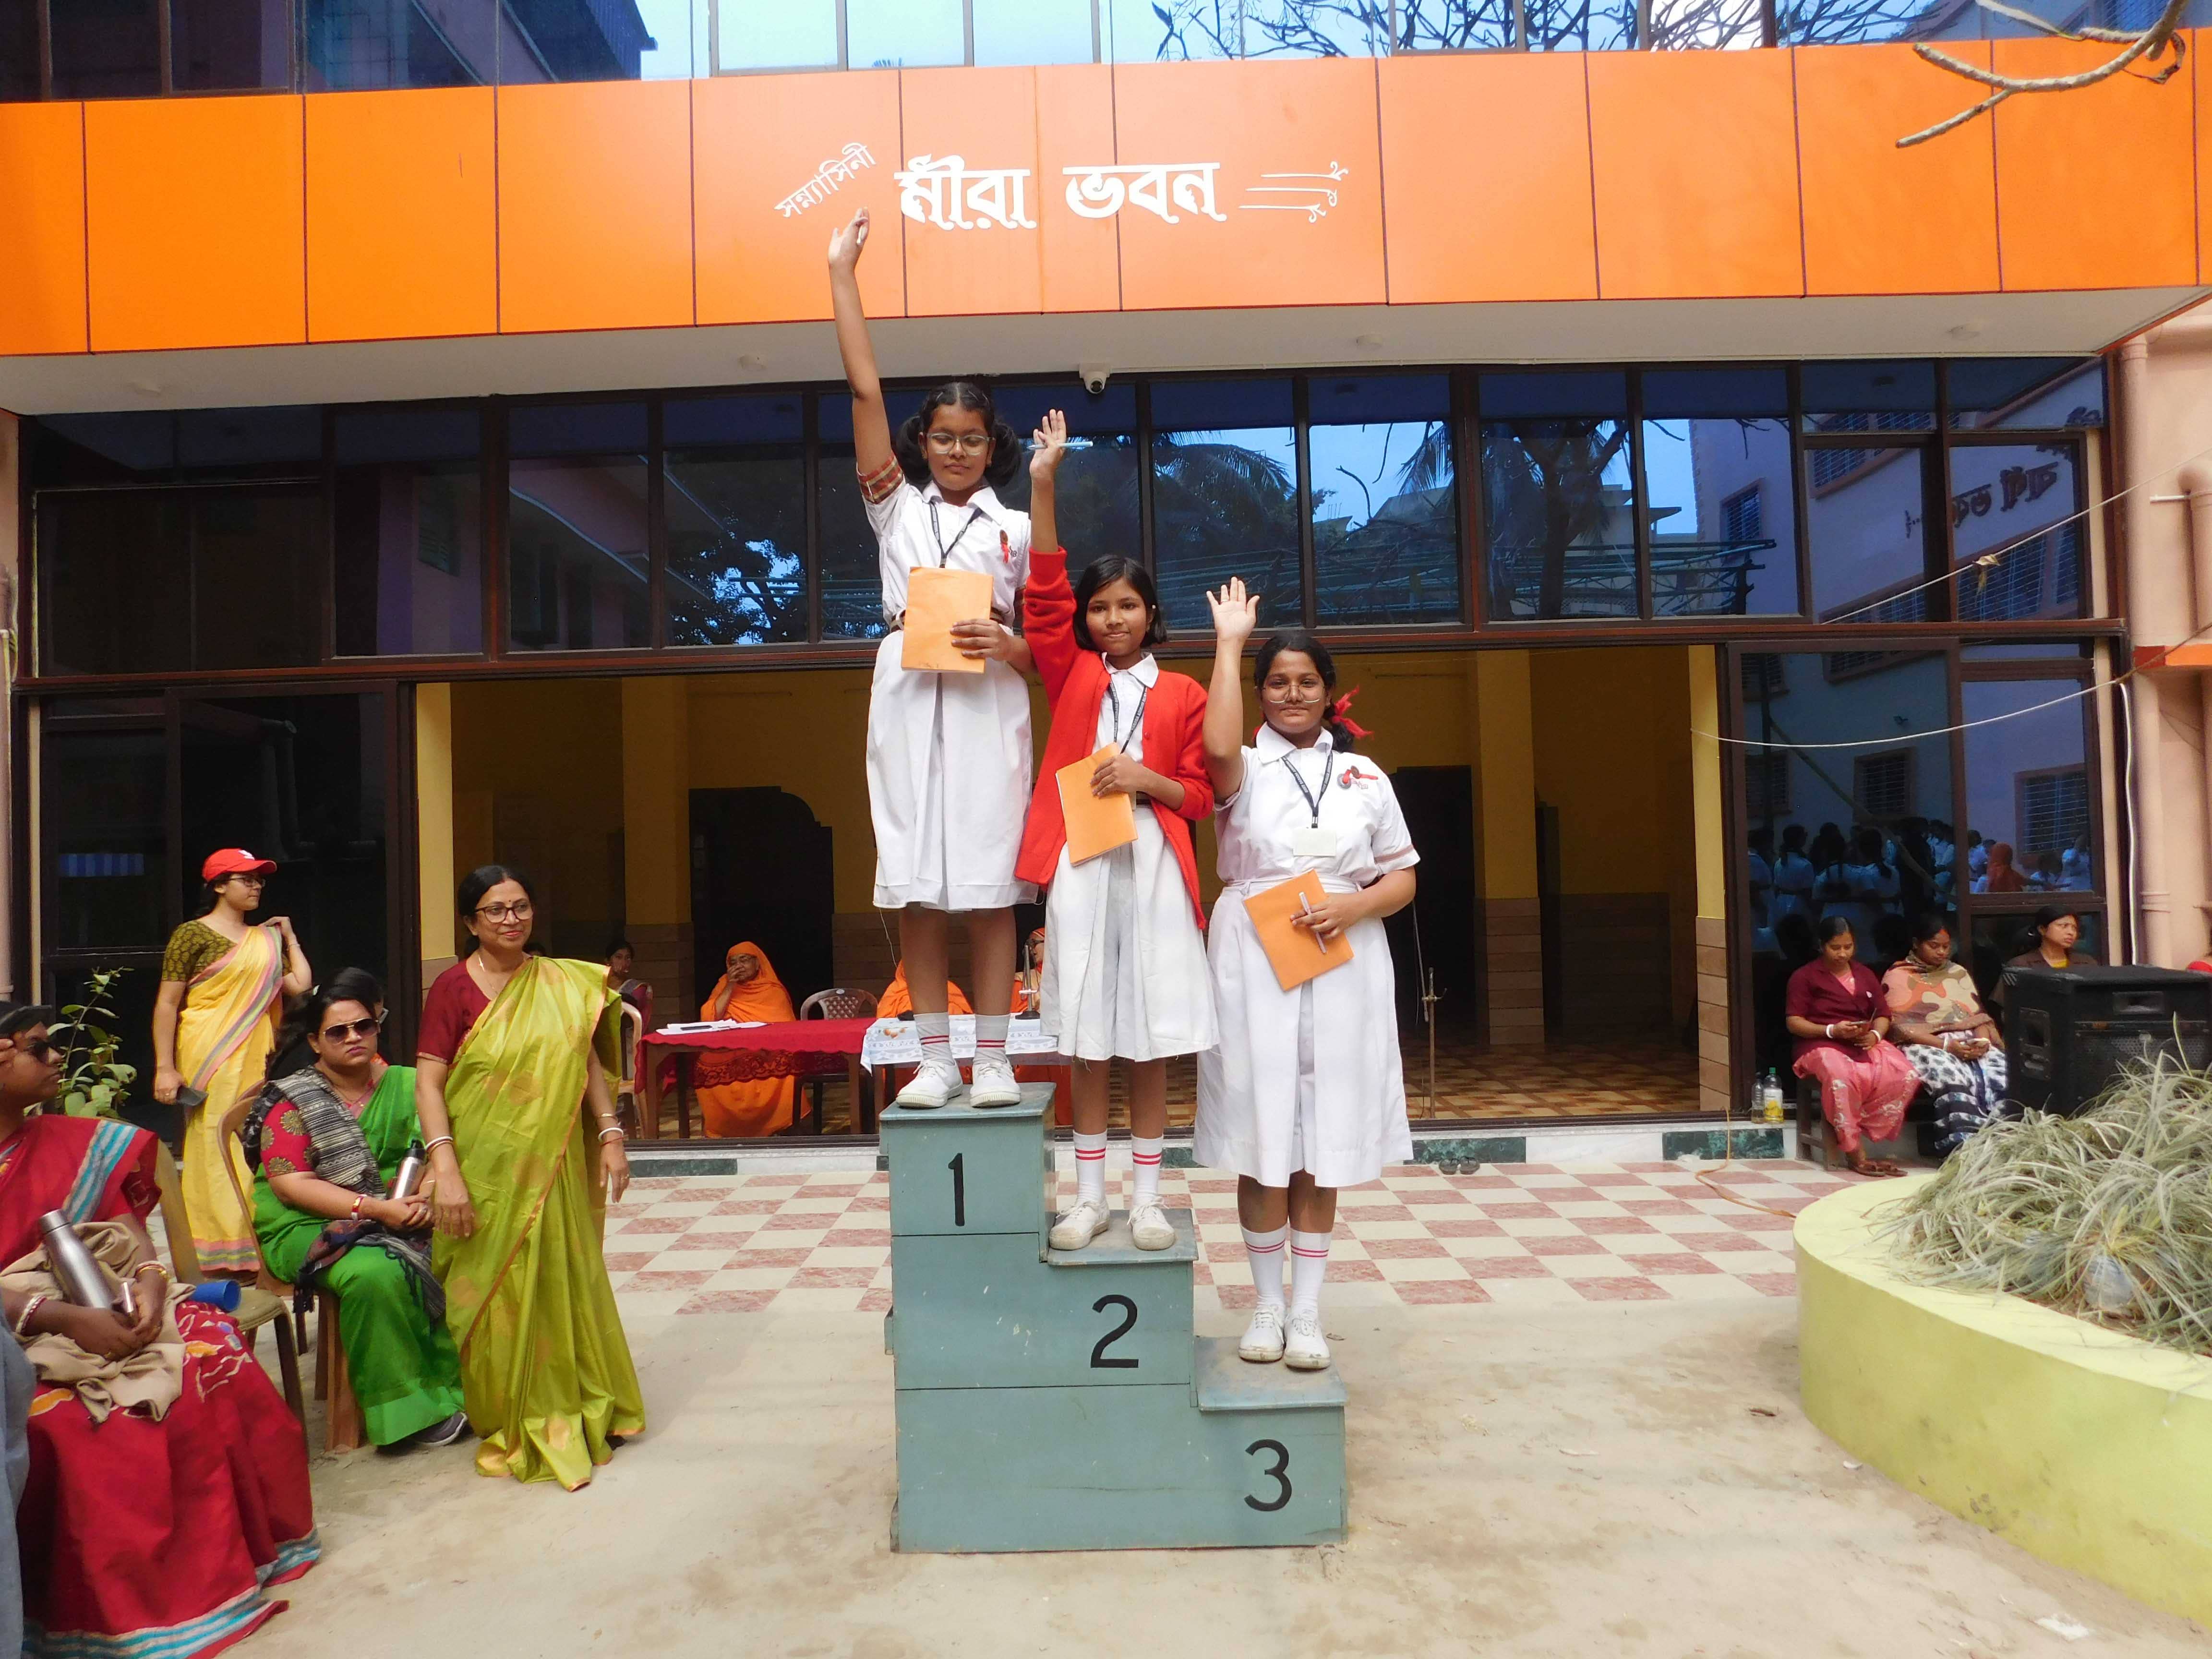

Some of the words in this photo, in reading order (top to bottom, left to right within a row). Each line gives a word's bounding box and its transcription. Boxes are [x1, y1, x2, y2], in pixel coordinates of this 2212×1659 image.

[893, 153, 1037, 231] মীরা
[1062, 162, 1227, 224] ভবন
[948, 1153, 965, 1226] 1
[1090, 1294, 1139, 1368] 2
[1243, 1439, 1292, 1512] 3
